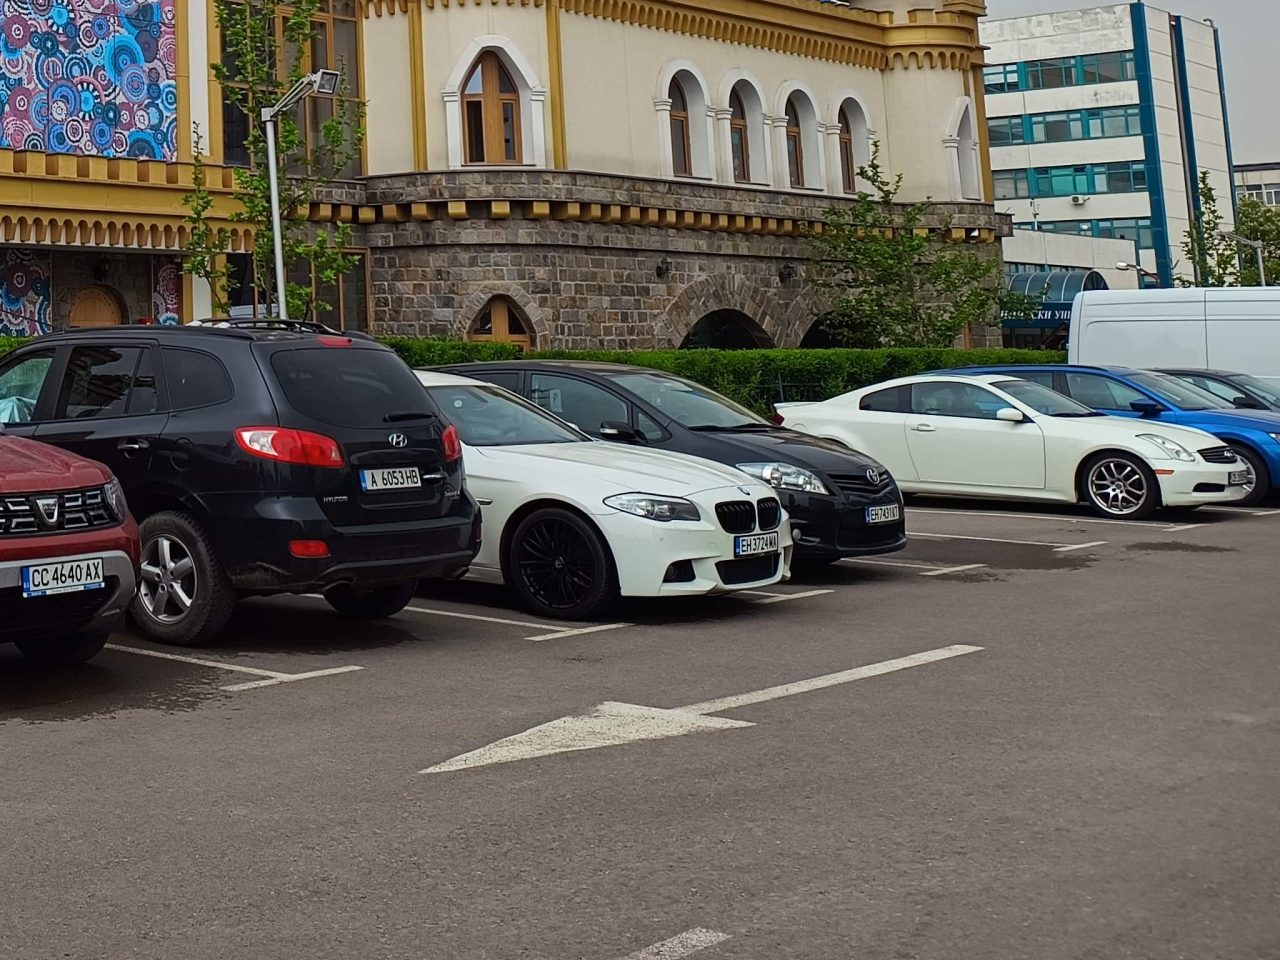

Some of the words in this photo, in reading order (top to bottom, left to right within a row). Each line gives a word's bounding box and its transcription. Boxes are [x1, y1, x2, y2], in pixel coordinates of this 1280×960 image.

[371, 472, 378, 487] A
[381, 470, 405, 486] 6053
[406, 469, 419, 484] HB
[32, 568, 50, 588] CC
[51, 563, 83, 585] 4640
[85, 561, 101, 581] AX
